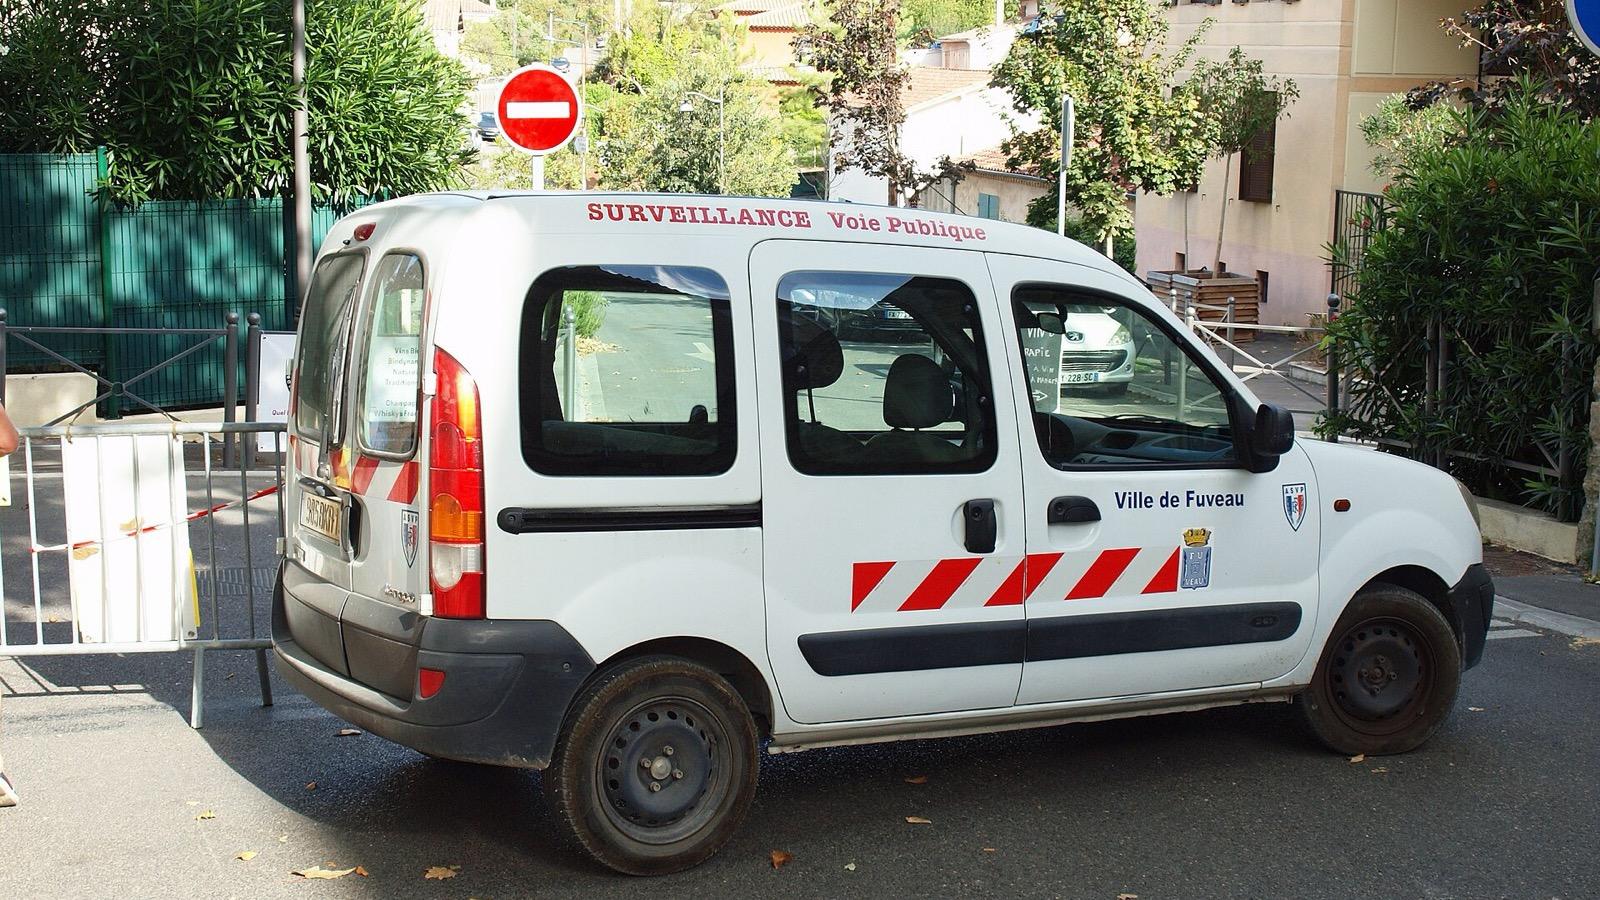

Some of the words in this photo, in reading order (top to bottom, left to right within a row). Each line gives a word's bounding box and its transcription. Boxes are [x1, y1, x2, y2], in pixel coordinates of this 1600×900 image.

[587, 202, 812, 228] SURVEILLANCE
[827, 211, 881, 232] Voie
[886, 216, 987, 242] Publique
[1115, 491, 1154, 509] Ville
[1159, 491, 1180, 508] de
[1186, 490, 1244, 508] Fuveau
